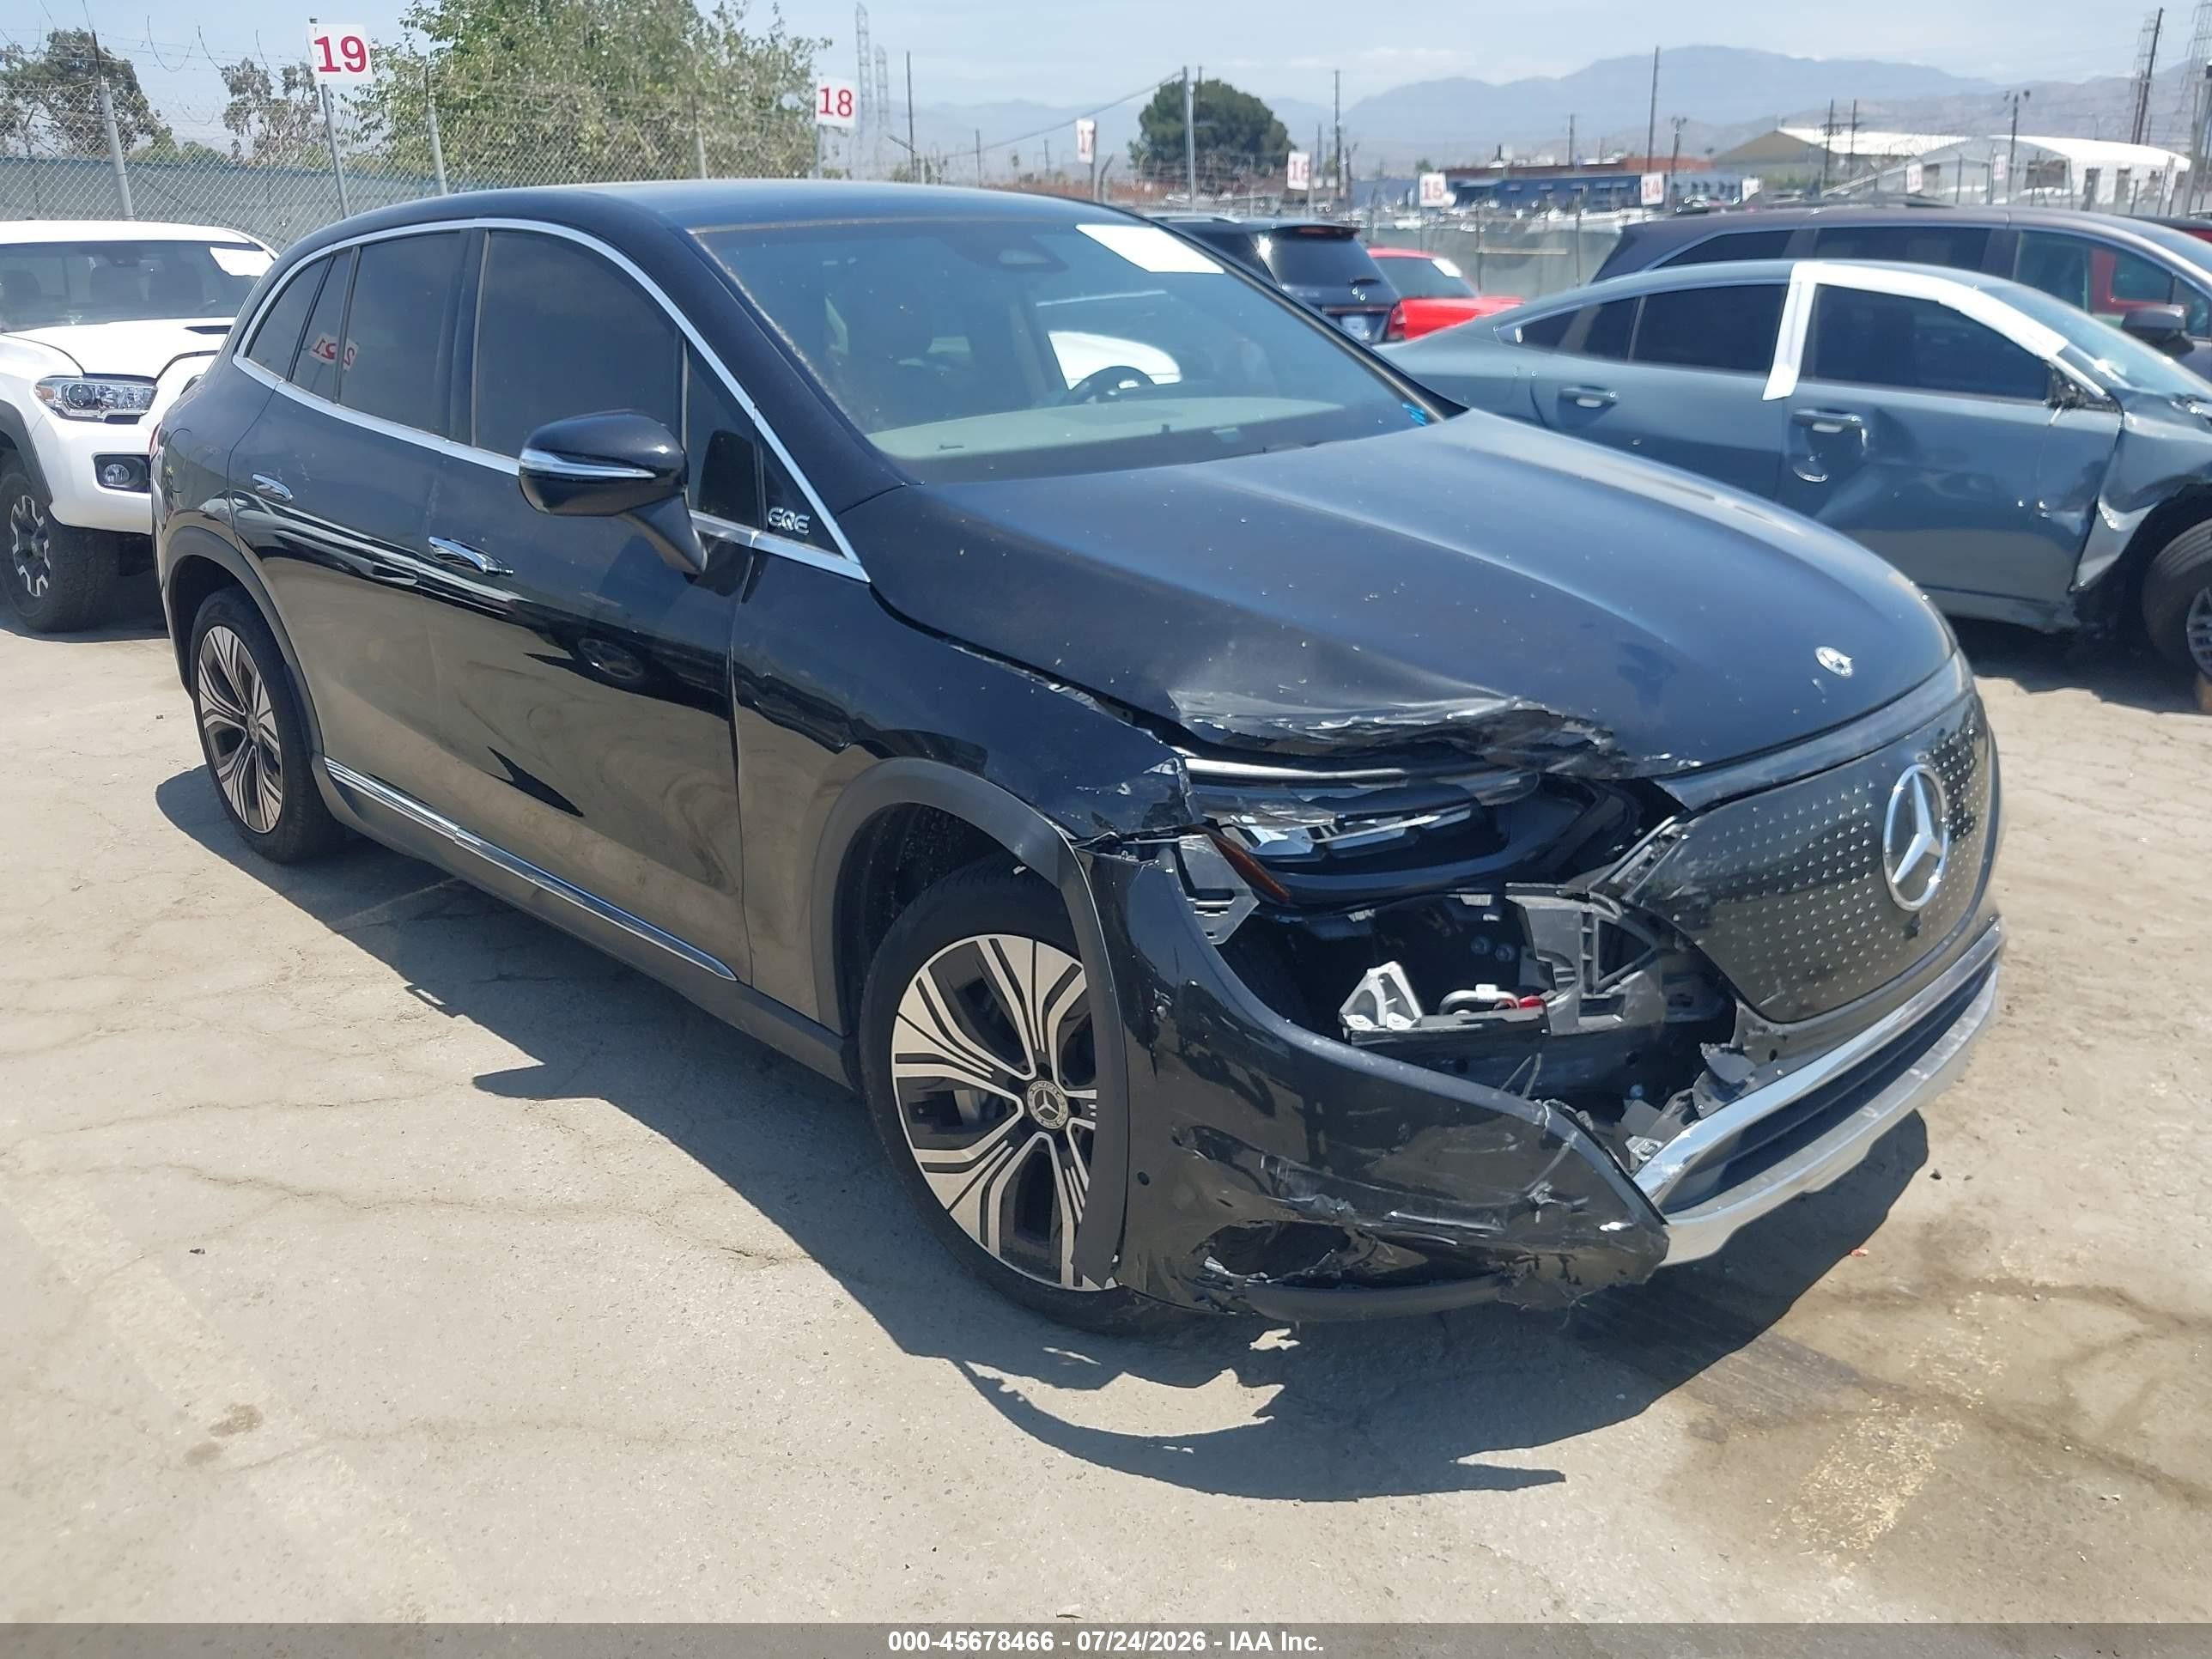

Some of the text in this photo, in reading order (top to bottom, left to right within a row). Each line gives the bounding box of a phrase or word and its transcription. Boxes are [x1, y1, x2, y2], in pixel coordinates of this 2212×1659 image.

[313, 35, 367, 72] 19
[818, 87, 852, 117] 18
[769, 507, 811, 534] EQE
